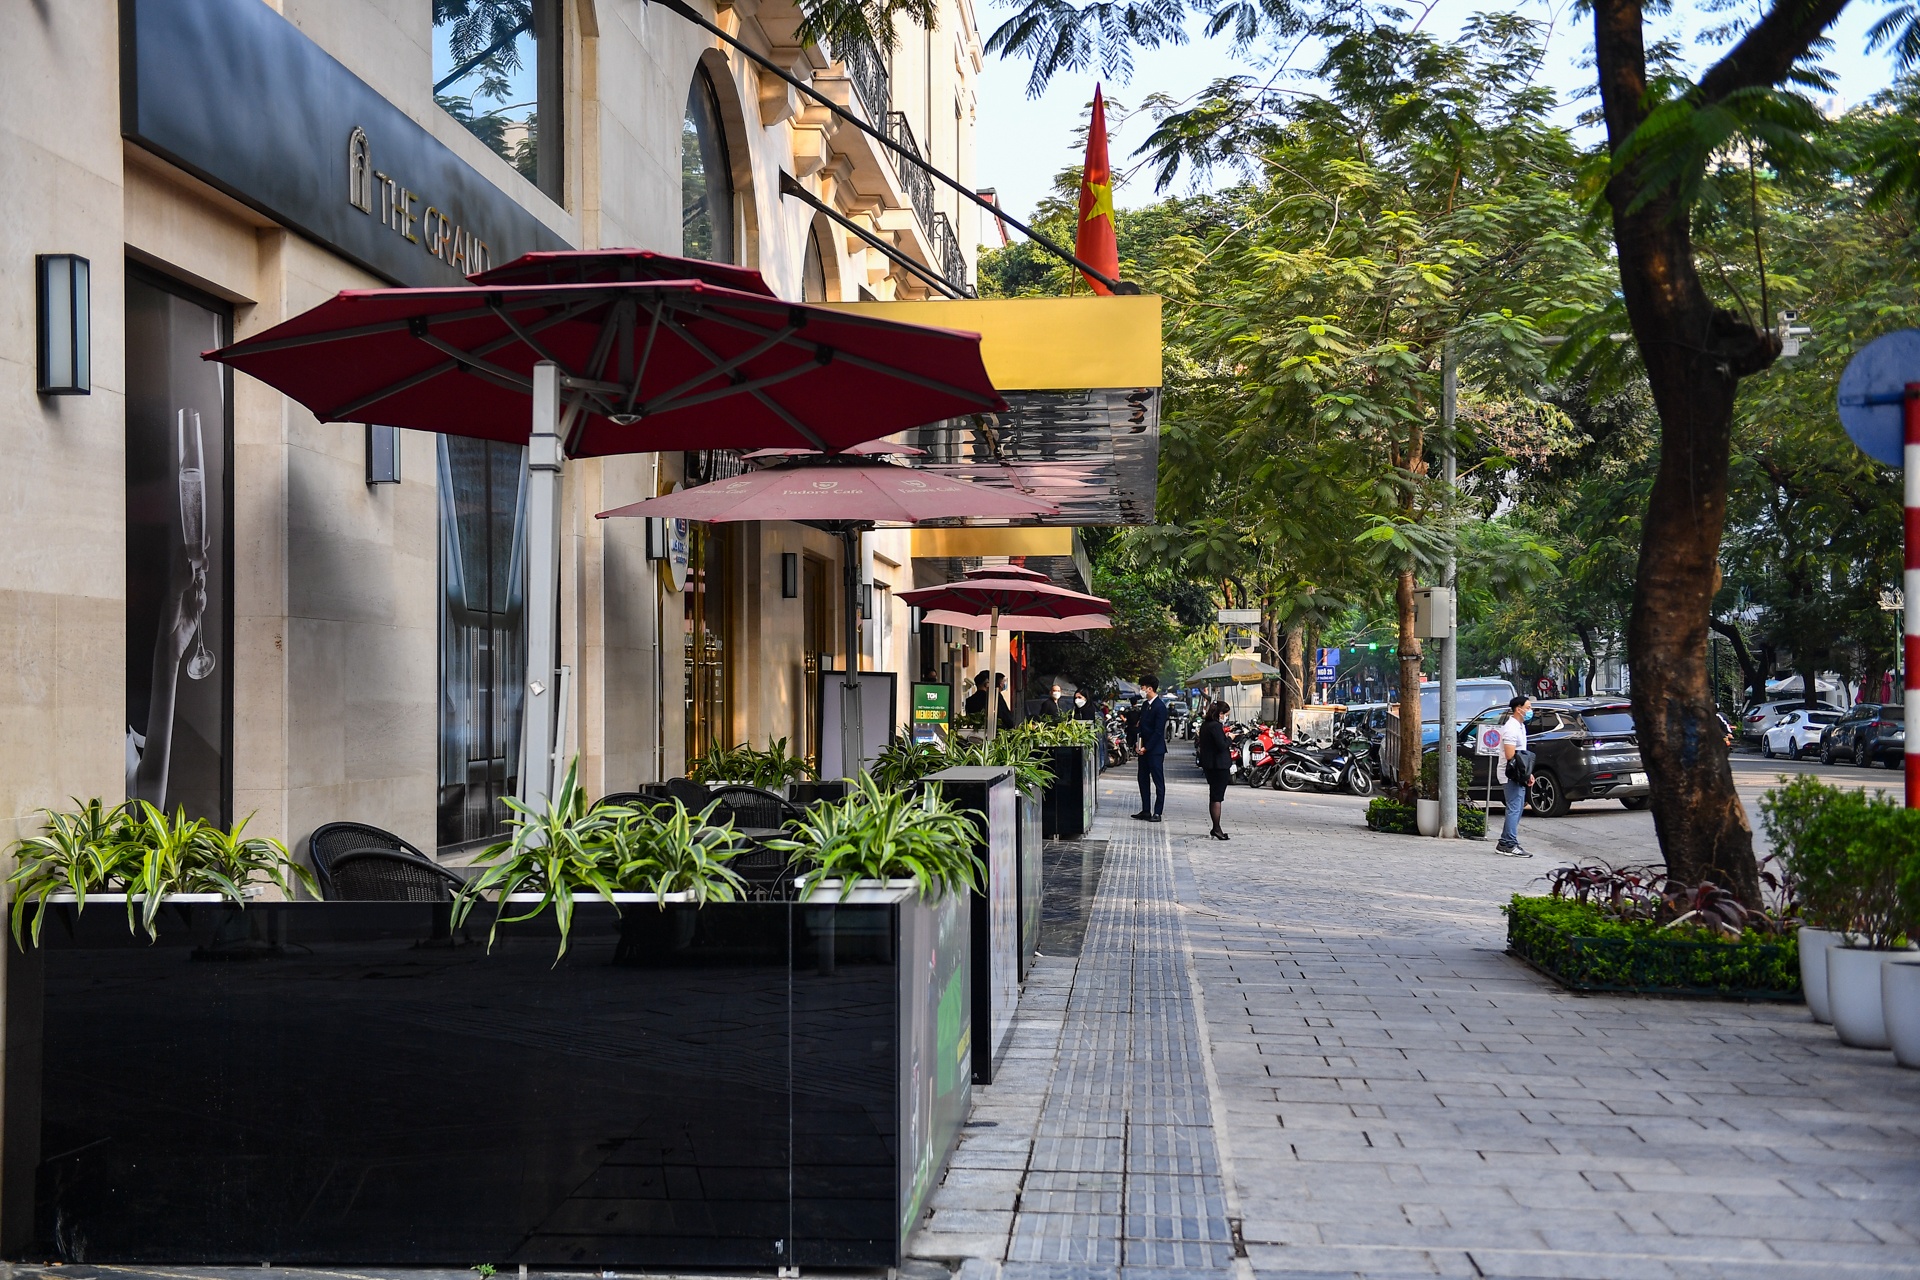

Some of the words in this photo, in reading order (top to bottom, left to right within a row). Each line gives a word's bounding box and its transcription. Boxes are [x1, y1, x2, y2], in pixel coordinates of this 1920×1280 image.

[374, 170, 419, 244] THE
[424, 206, 491, 275] GRAND
[916, 710, 946, 719] MEMBERSHIP
